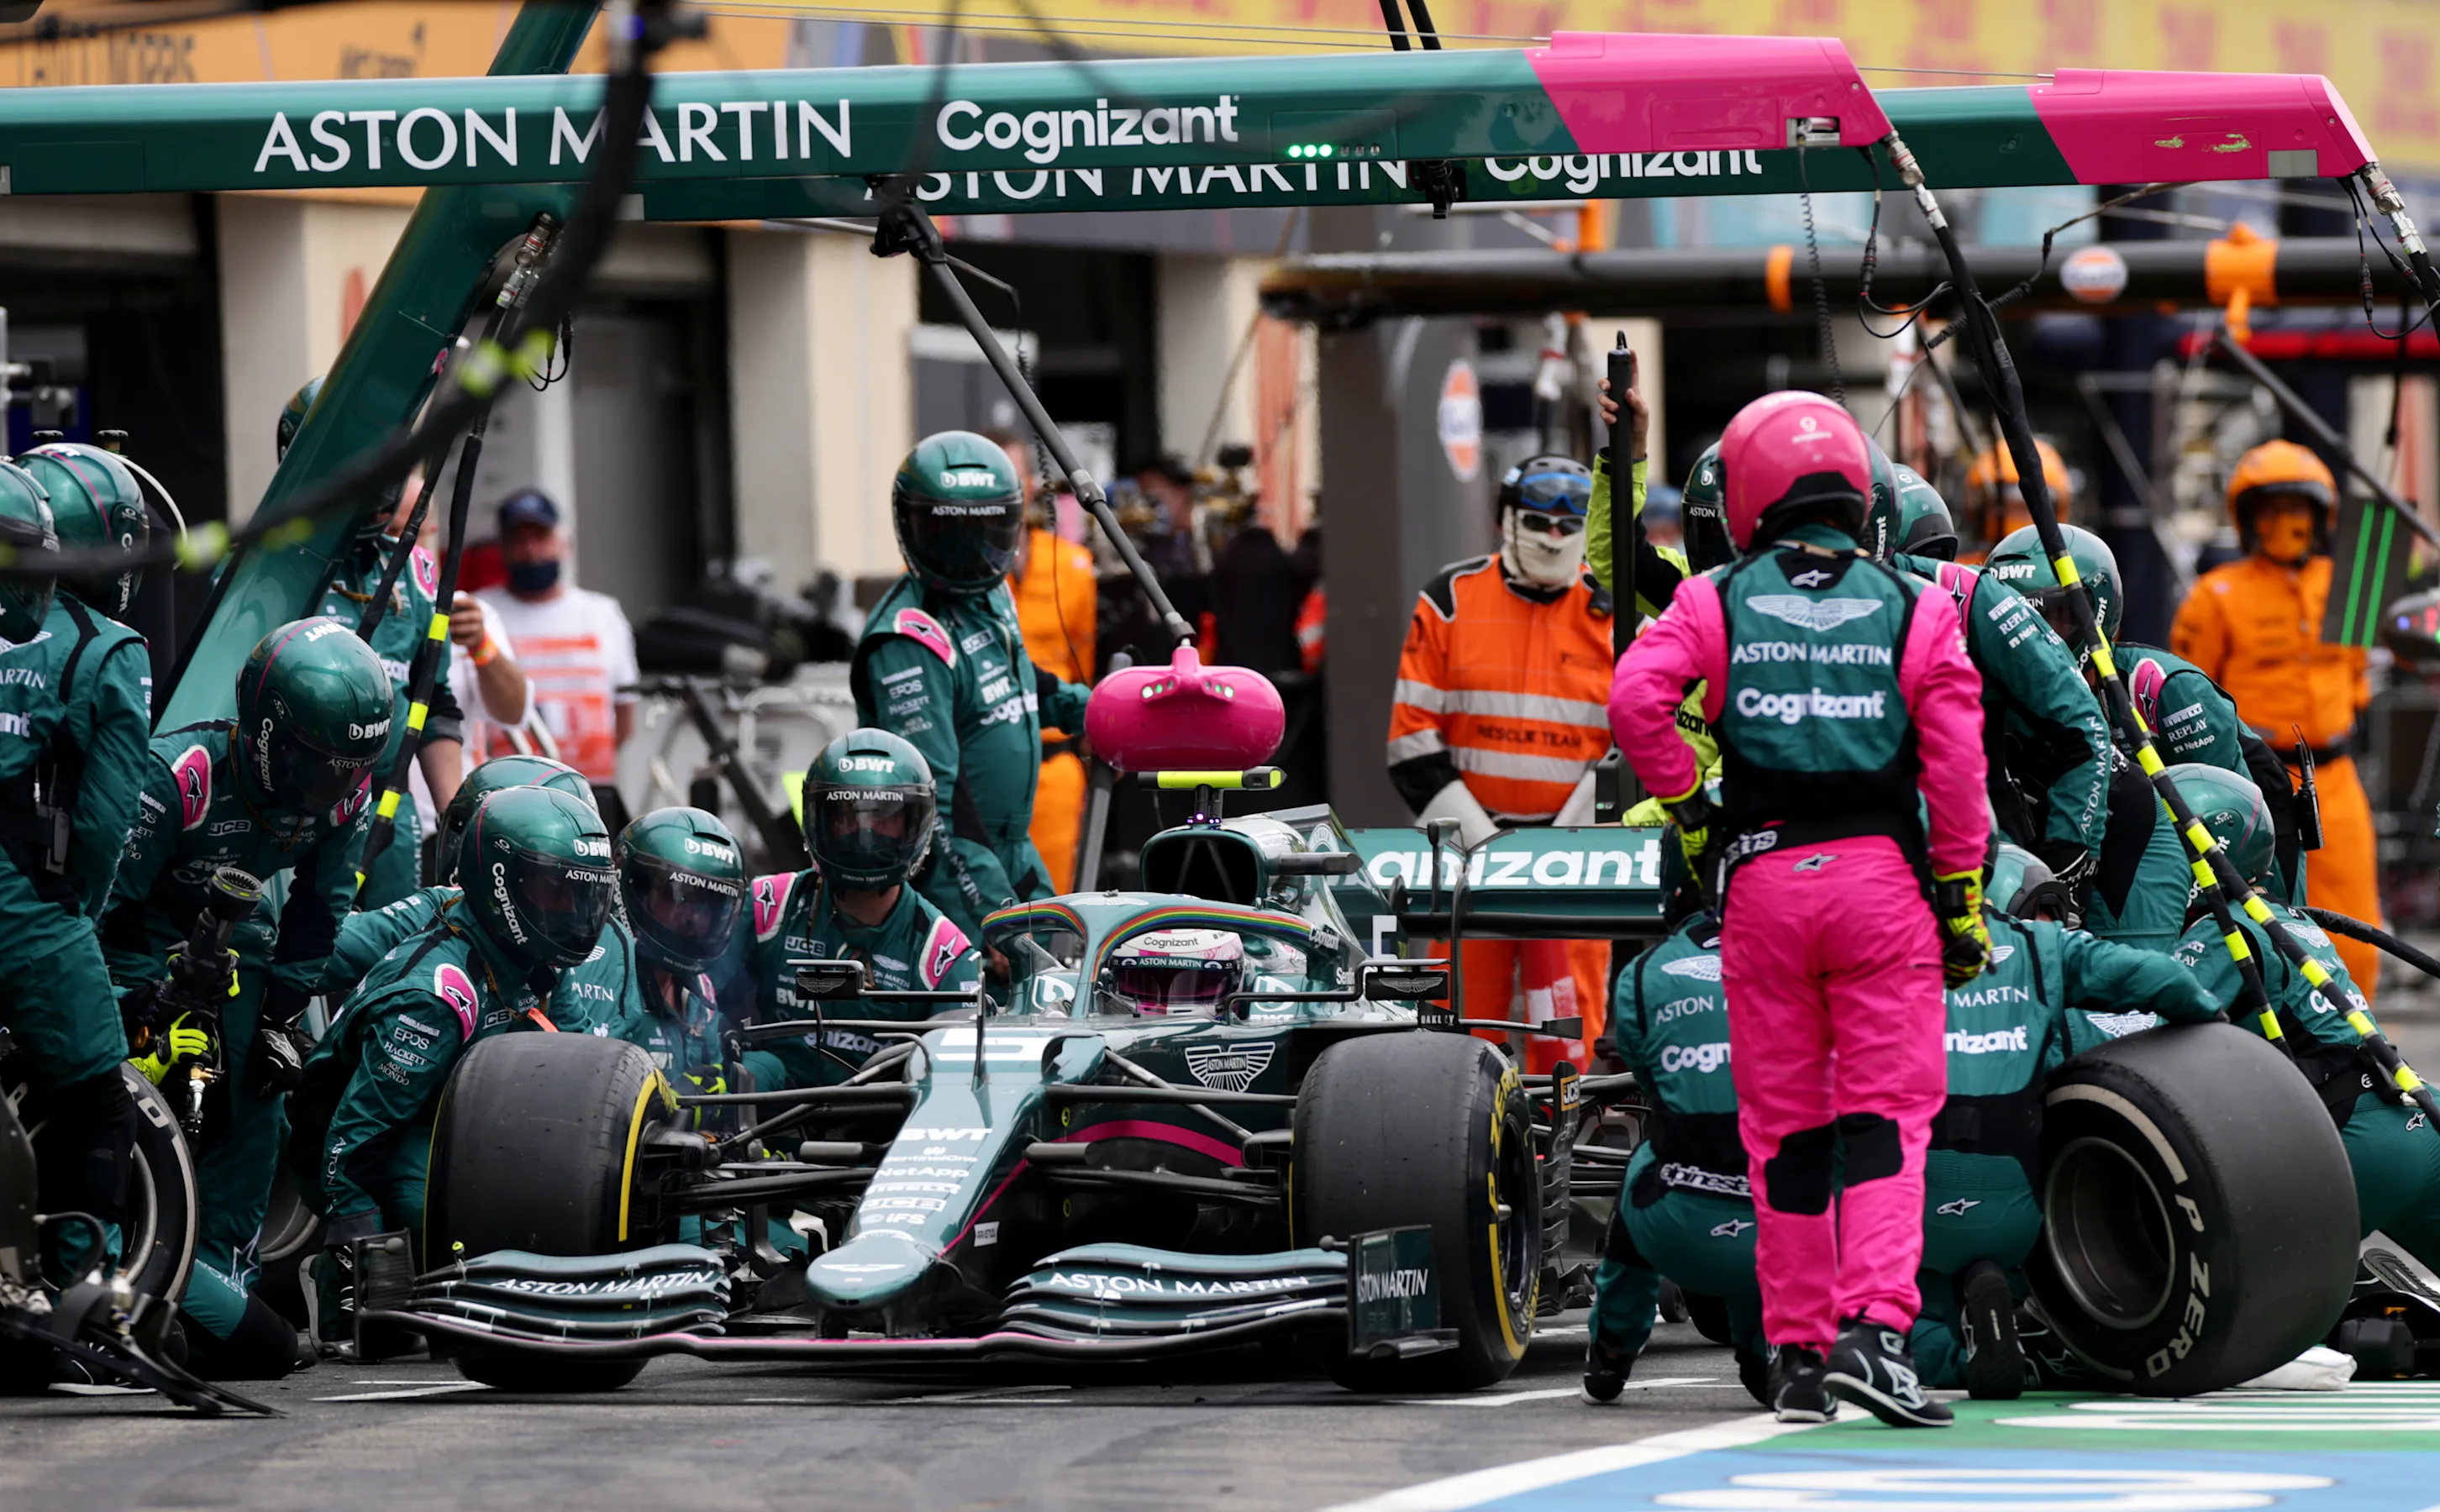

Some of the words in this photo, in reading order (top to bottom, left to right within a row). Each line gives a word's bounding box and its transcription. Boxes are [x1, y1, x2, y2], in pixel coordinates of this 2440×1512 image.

[253, 107, 518, 172] ASTON
[549, 98, 852, 165] MARTIN
[936, 94, 1239, 165] Cognizant
[959, 472, 996, 487] BWT
[931, 505, 966, 516] ASTON
[968, 505, 1007, 516] MARTIN
[1689, 507, 1716, 517] ASTON
[1998, 564, 2036, 580] BWT
[1732, 641, 1806, 664] ASTON
[1810, 644, 1891, 666] MARTIN
[1736, 687, 1885, 725] Cognizant
[364, 718, 391, 738] BWT
[1477, 724, 1535, 743] RESCUE
[1542, 731, 1581, 748] TEAM
[2167, 718, 2209, 743] REPLAY
[2185, 734, 2216, 751] NetApp
[256, 717, 275, 791] Cognizant
[855, 759, 896, 774] BWT
[826, 790, 861, 801] ASTON
[862, 790, 904, 801] MARTIN
[2080, 781, 2102, 835] ASTON
[702, 843, 734, 864] BWT
[565, 869, 598, 882] ASTON
[670, 872, 706, 888] ASTON
[707, 881, 739, 898] MARTIN
[492, 863, 529, 945] Cognizant
[791, 937, 825, 955] JCB
[1144, 937, 1199, 949] Cognizant
[1308, 923, 1340, 951] Cognizant
[1138, 958, 1167, 967] ASTON
[1168, 958, 1202, 968] MARTIN
[571, 981, 615, 1003] MARTIN
[1954, 984, 2029, 1008] MARTIN
[1655, 995, 1714, 1026] ASTON
[393, 1026, 430, 1050] EPOS
[384, 1041, 428, 1067] HACKETT
[391, 1053, 414, 1067] LONDON
[1207, 1058, 1223, 1071] ASTON
[1223, 1057, 1246, 1069] MARTIN
[378, 1063, 410, 1087] MONDO
[386, 1060, 408, 1078] AQUA
[897, 1127, 993, 1141] BWT
[874, 1166, 970, 1179] NetApp
[886, 1213, 927, 1225] IFS
[2174, 1193, 2206, 1233] P
[490, 1278, 598, 1294] ASTON
[597, 1270, 714, 1294] MARTIN
[1050, 1272, 1164, 1294] ASTON
[1175, 1275, 1309, 1294] MARTIN
[1381, 1268, 1428, 1299] MARTIN
[2145, 1251, 2211, 1378] ZERO
